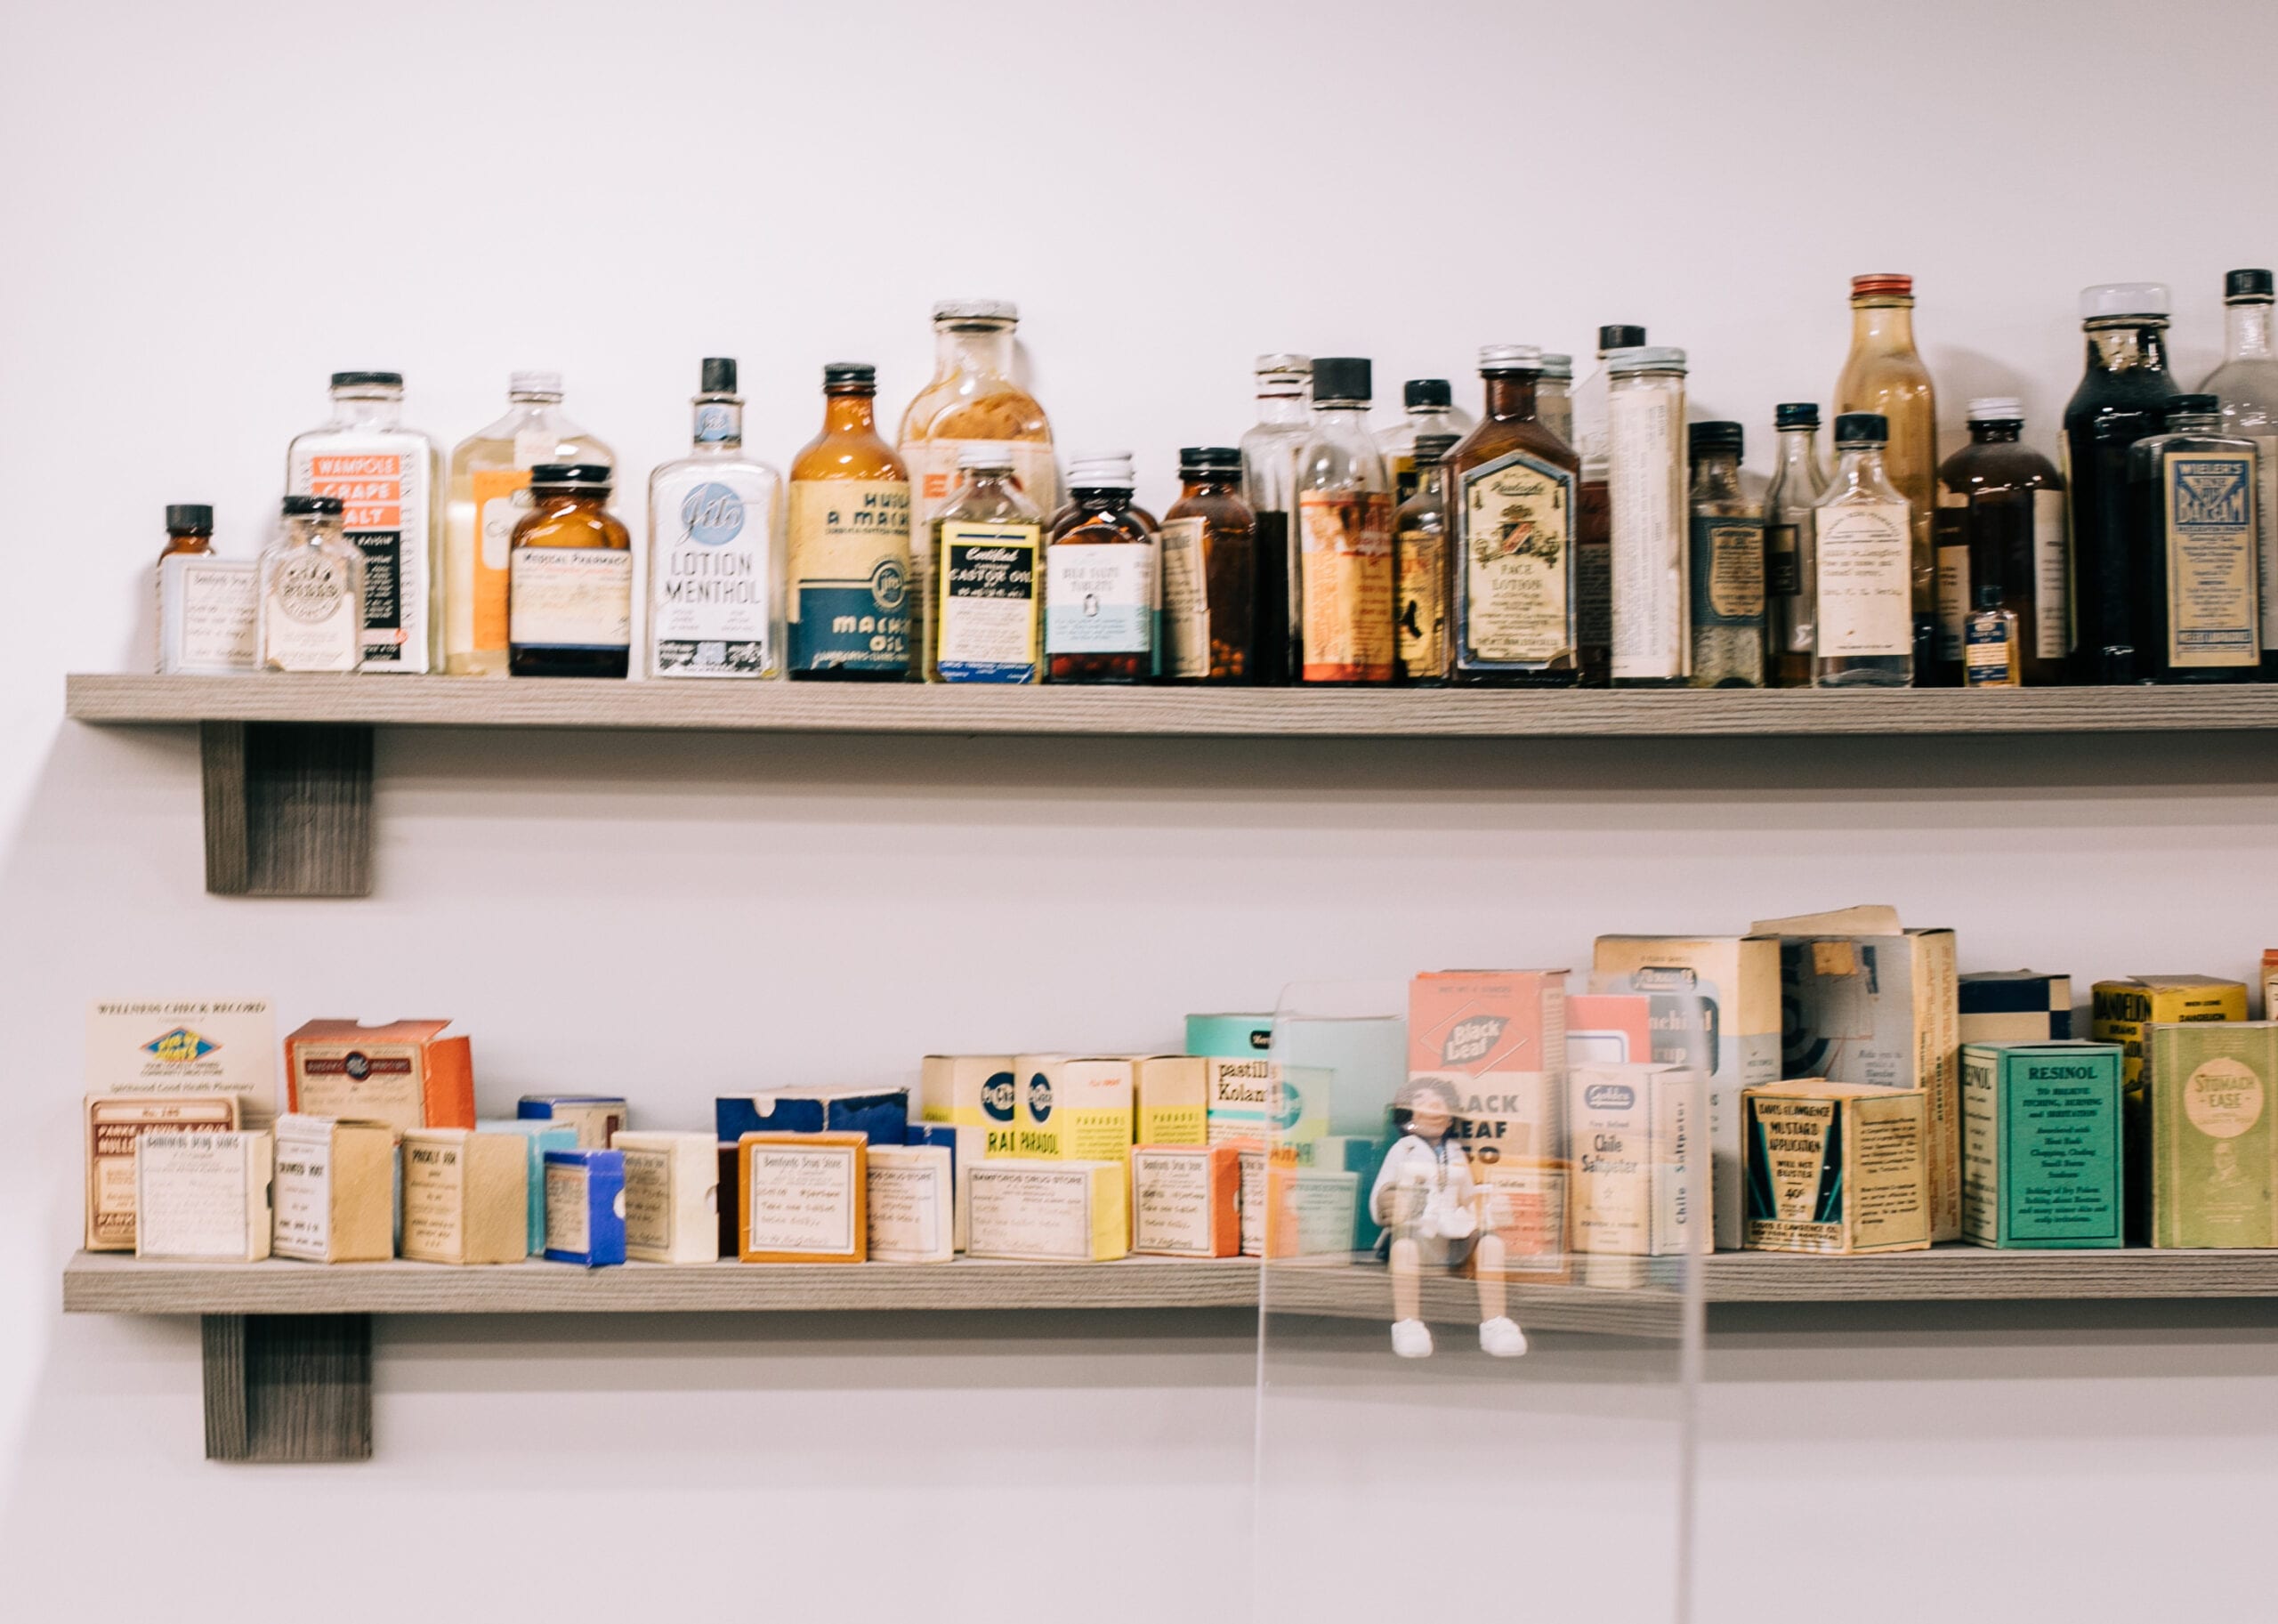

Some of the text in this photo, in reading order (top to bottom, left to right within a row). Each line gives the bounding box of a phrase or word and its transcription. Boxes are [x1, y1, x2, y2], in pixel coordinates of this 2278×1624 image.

[317, 458, 395, 475] WAMPOLE
[323, 482, 392, 500] GRAPE
[343, 509, 384, 525] ALT
[670, 553, 754, 576] LOTION
[949, 569, 1033, 583] CASTOR OIL
[666, 579, 761, 603] MENTHOL
[1452, 1020, 1500, 1042] Black
[1446, 1037, 1488, 1061] Leaf
[2029, 1066, 2098, 1080] RESINOL
[2209, 1094, 2242, 1109] EASE
[1449, 1120, 1507, 1139] LEAF
[1769, 1122, 1819, 1136] MUSTARD
[1594, 1134, 1623, 1152] Chile
[1768, 1138, 1822, 1153] APPLICATION
[1581, 1154, 1638, 1176] Saltpeter
[1674, 1102, 1687, 1224] Chile Saltpeter
